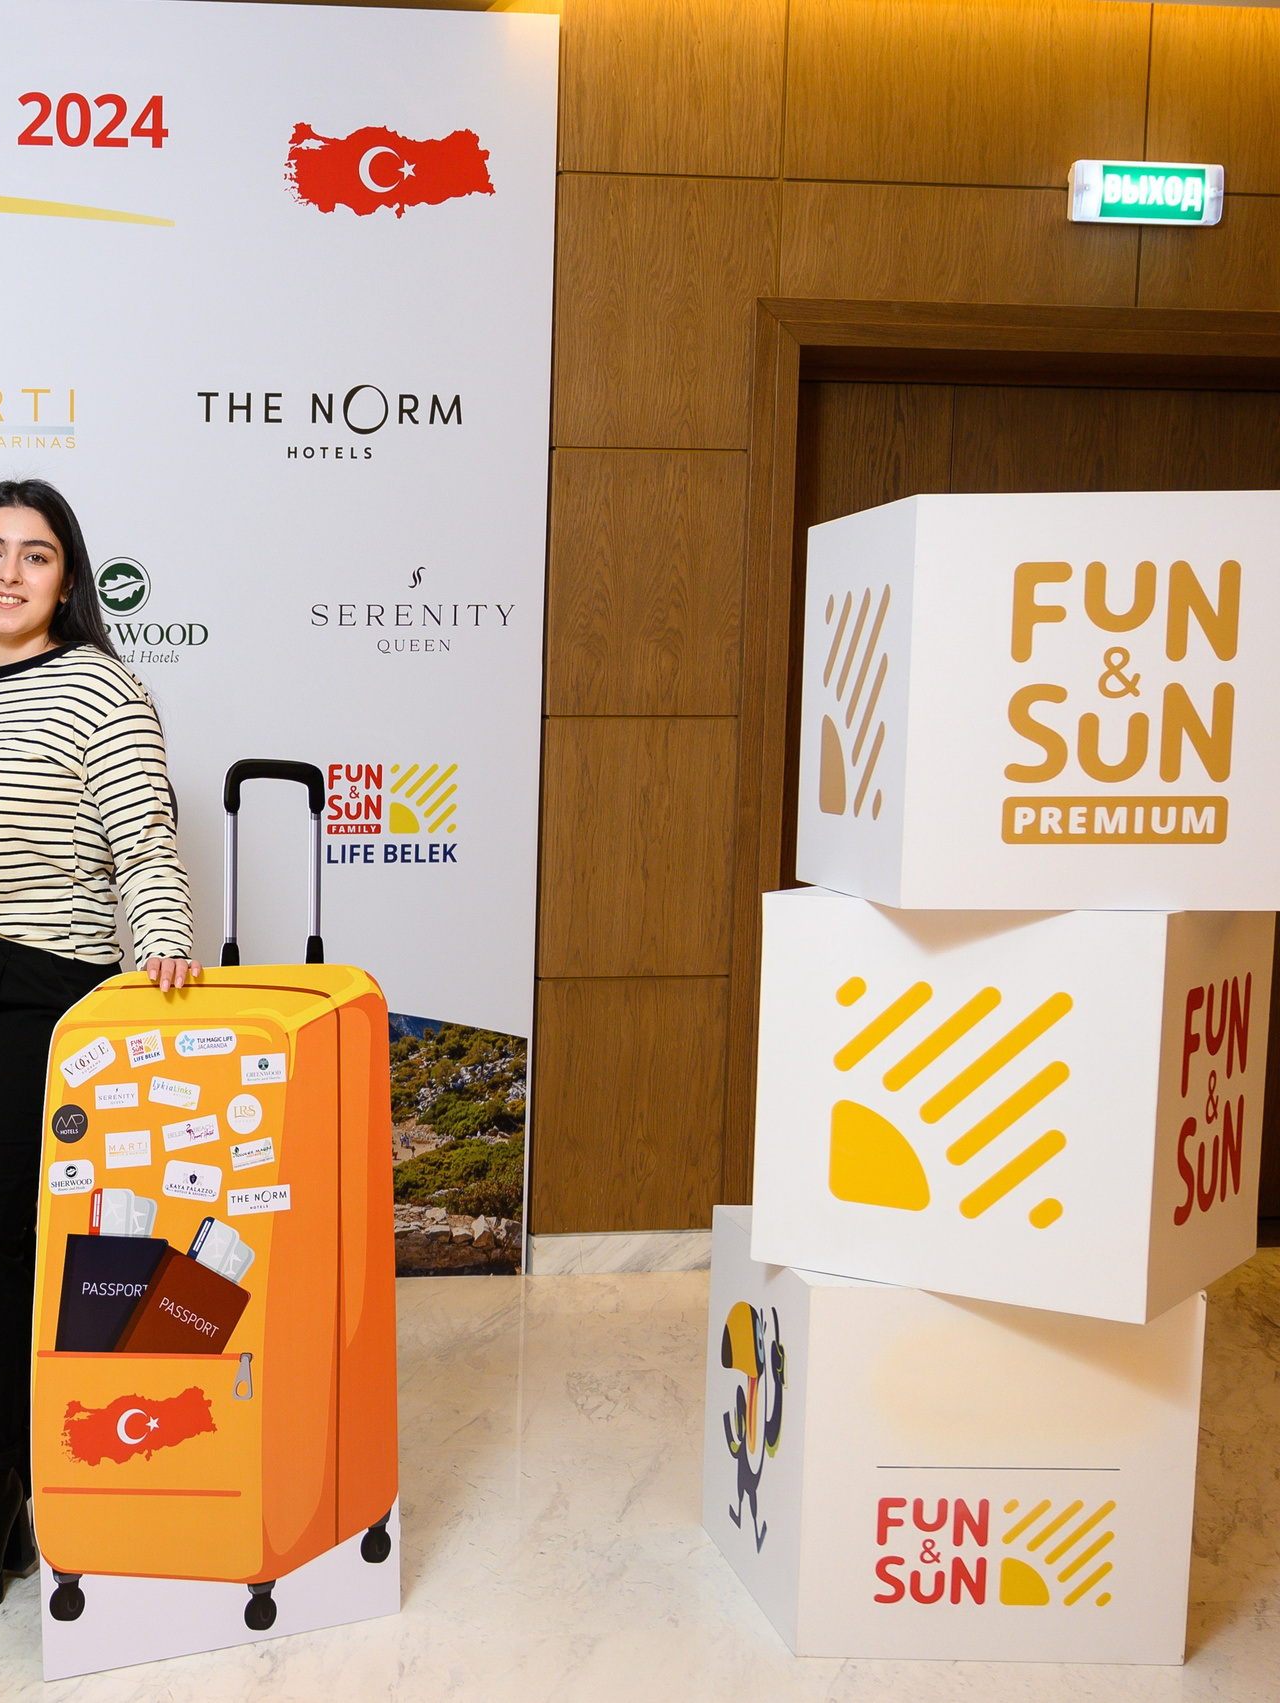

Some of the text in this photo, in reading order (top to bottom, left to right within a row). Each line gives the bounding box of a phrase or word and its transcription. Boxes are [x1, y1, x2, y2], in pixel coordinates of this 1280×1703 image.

[18, 92, 168, 149] 2024
[1104, 174, 1203, 212] ВЫХОД
[197, 384, 463, 434] THE NORM
[287, 446, 373, 460] HOTELS
[310, 603, 516, 628] SERENITY
[1011, 560, 1242, 663] FUN
[140, 650, 180, 663] Hotels
[376, 638, 452, 654] QUEEN
[1098, 646, 1141, 699] &
[1004, 682, 1235, 783] SUN
[328, 764, 382, 790] FUN
[349, 785, 360, 799] &
[327, 794, 382, 820] SUN
[332, 825, 377, 833] FAMILY
[1013, 806, 1216, 835] PREMIUM
[327, 843, 458, 864] LIFE BELEK
[1182, 971, 1252, 1098] FUN
[64, 1042, 109, 1076] VOGUE
[98, 1093, 135, 1101] SERENITY
[1206, 1069, 1220, 1125] &
[109, 1142, 148, 1151] MARTI
[1174, 1094, 1245, 1226] SUN
[51, 1178, 92, 1188] SHERWOOD
[187, 1186, 213, 1194] PALAZZO
[231, 1190, 287, 1203] THE NORM
[158, 1297, 219, 1338] PASSPORT
[877, 1497, 990, 1547] FUN
[920, 1539, 941, 1564] &
[874, 1556, 987, 1605] SUN
